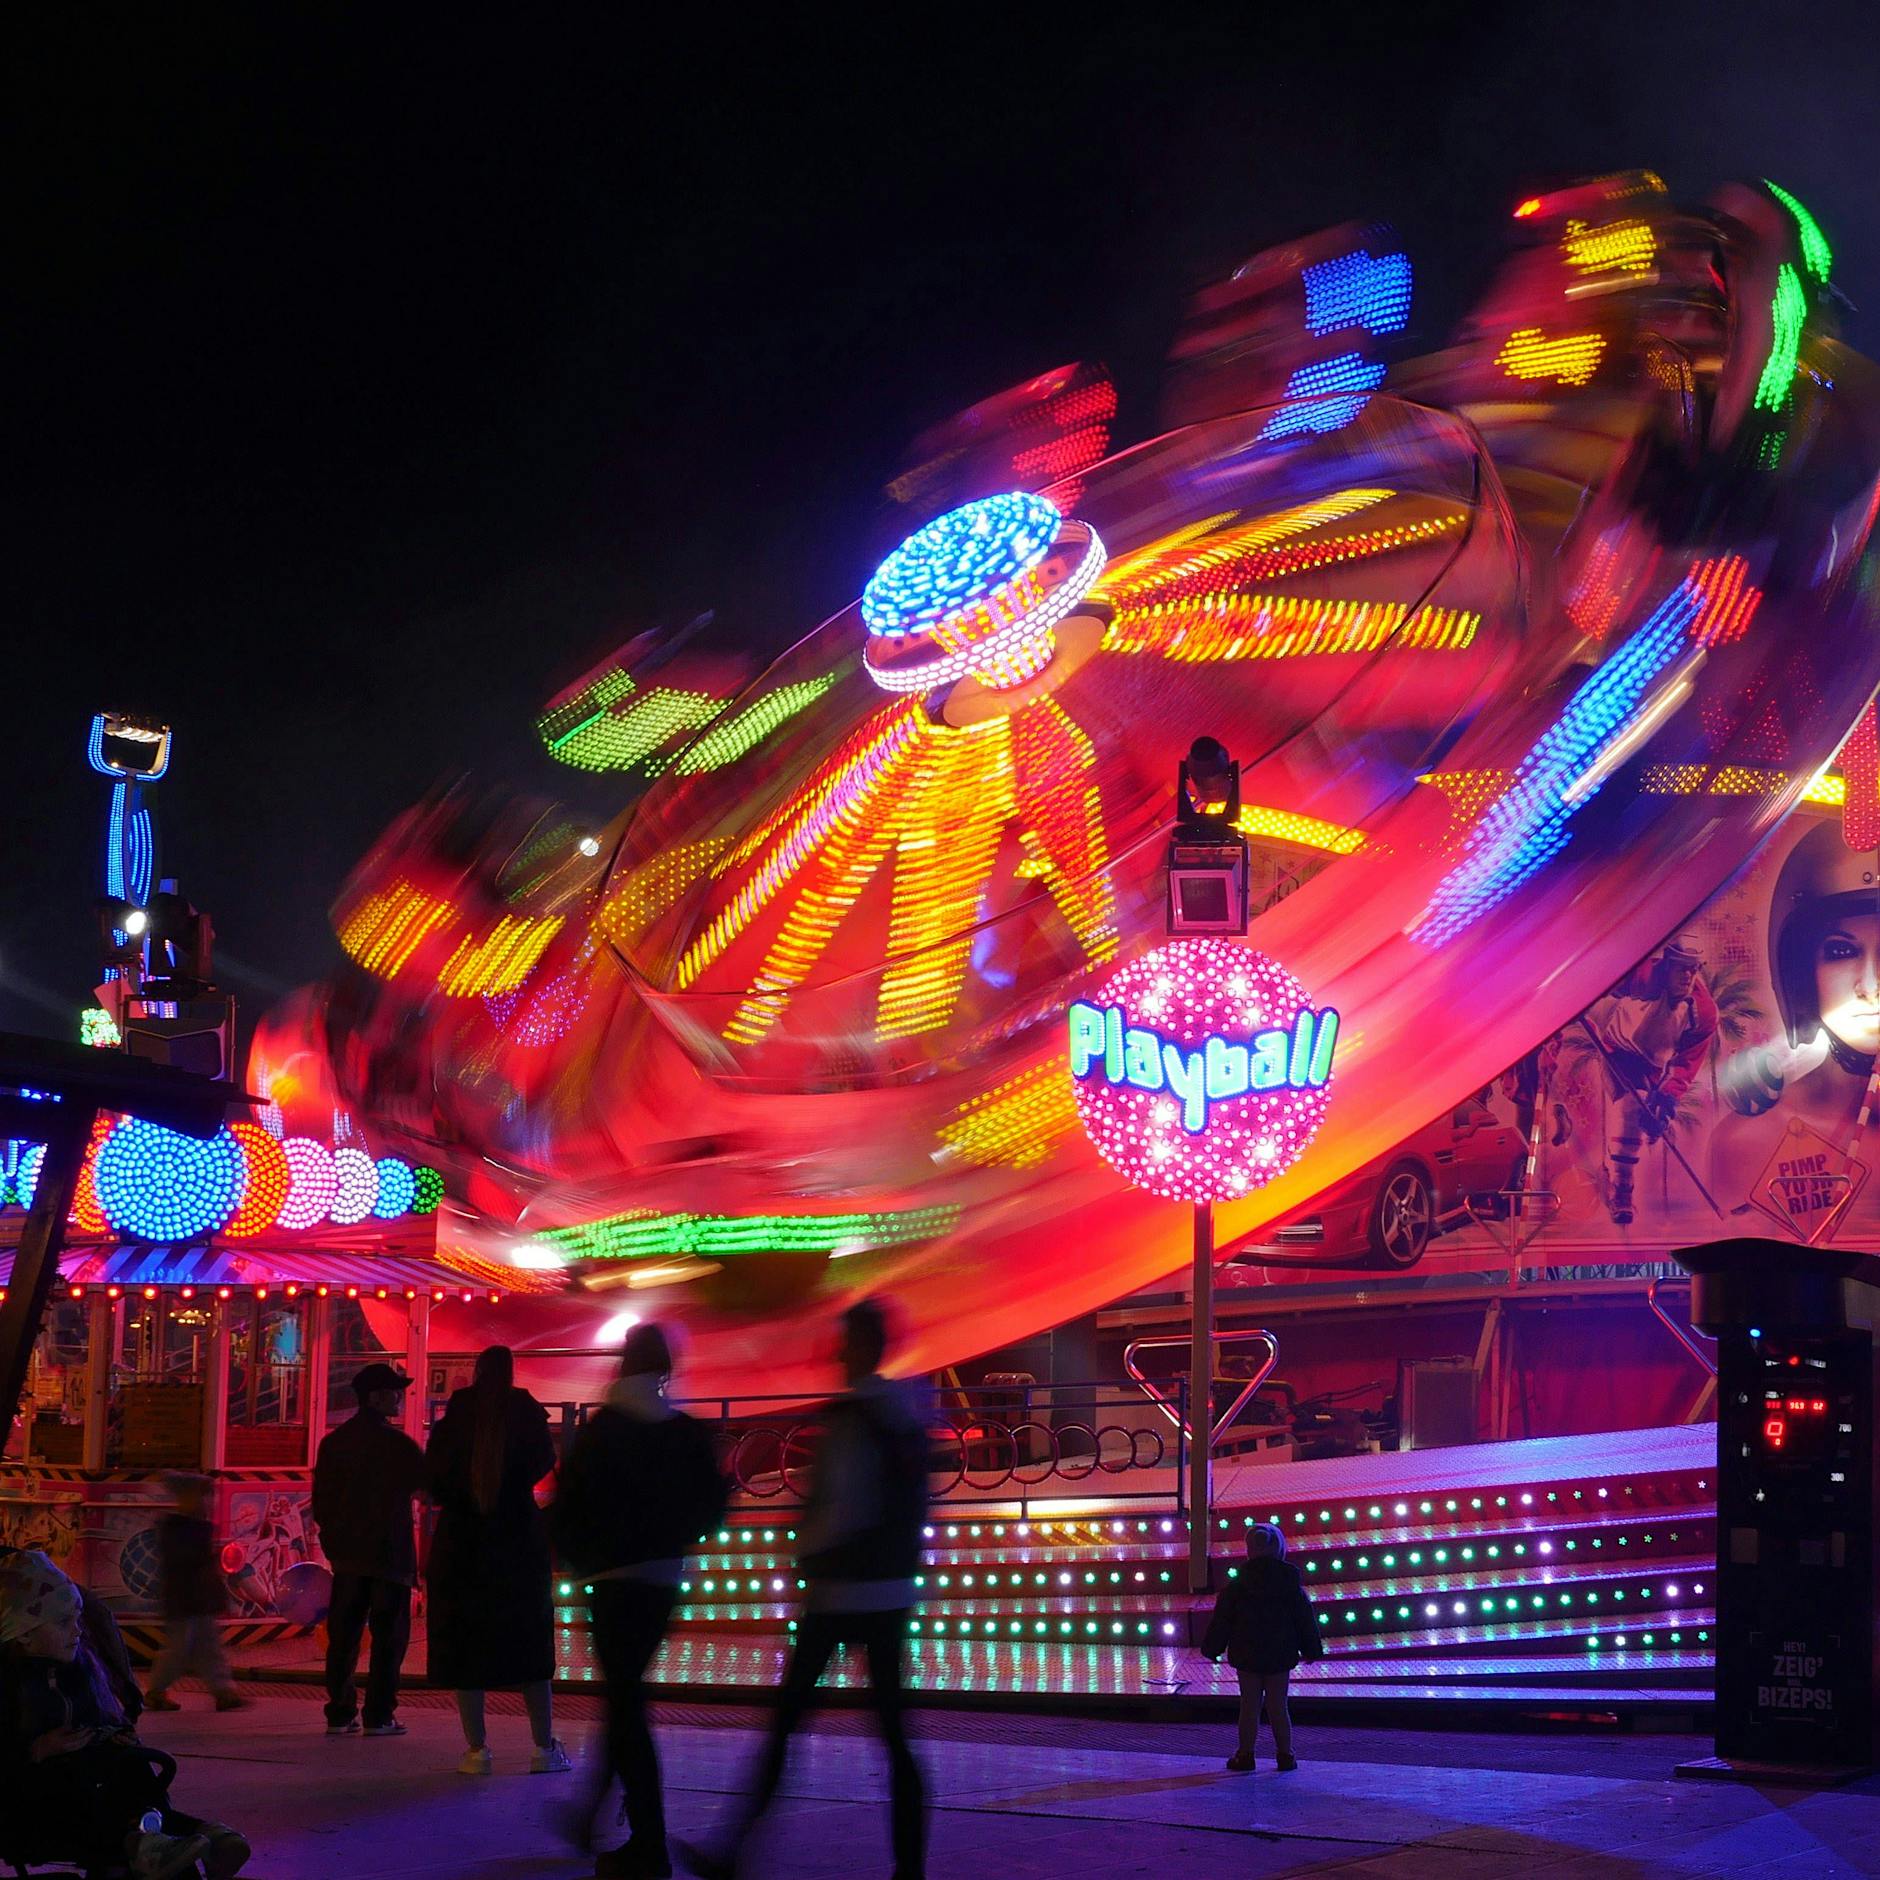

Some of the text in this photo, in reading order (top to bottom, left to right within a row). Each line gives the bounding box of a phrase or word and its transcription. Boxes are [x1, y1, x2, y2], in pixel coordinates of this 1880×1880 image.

[1067, 999, 1340, 1134] Playball
[1778, 1154, 1827, 1177] PIMP
[1788, 1190, 1834, 1214] RIDE
[1838, 1423, 1852, 1433] 700
[1757, 1685, 1833, 1711] BIZEPS!
